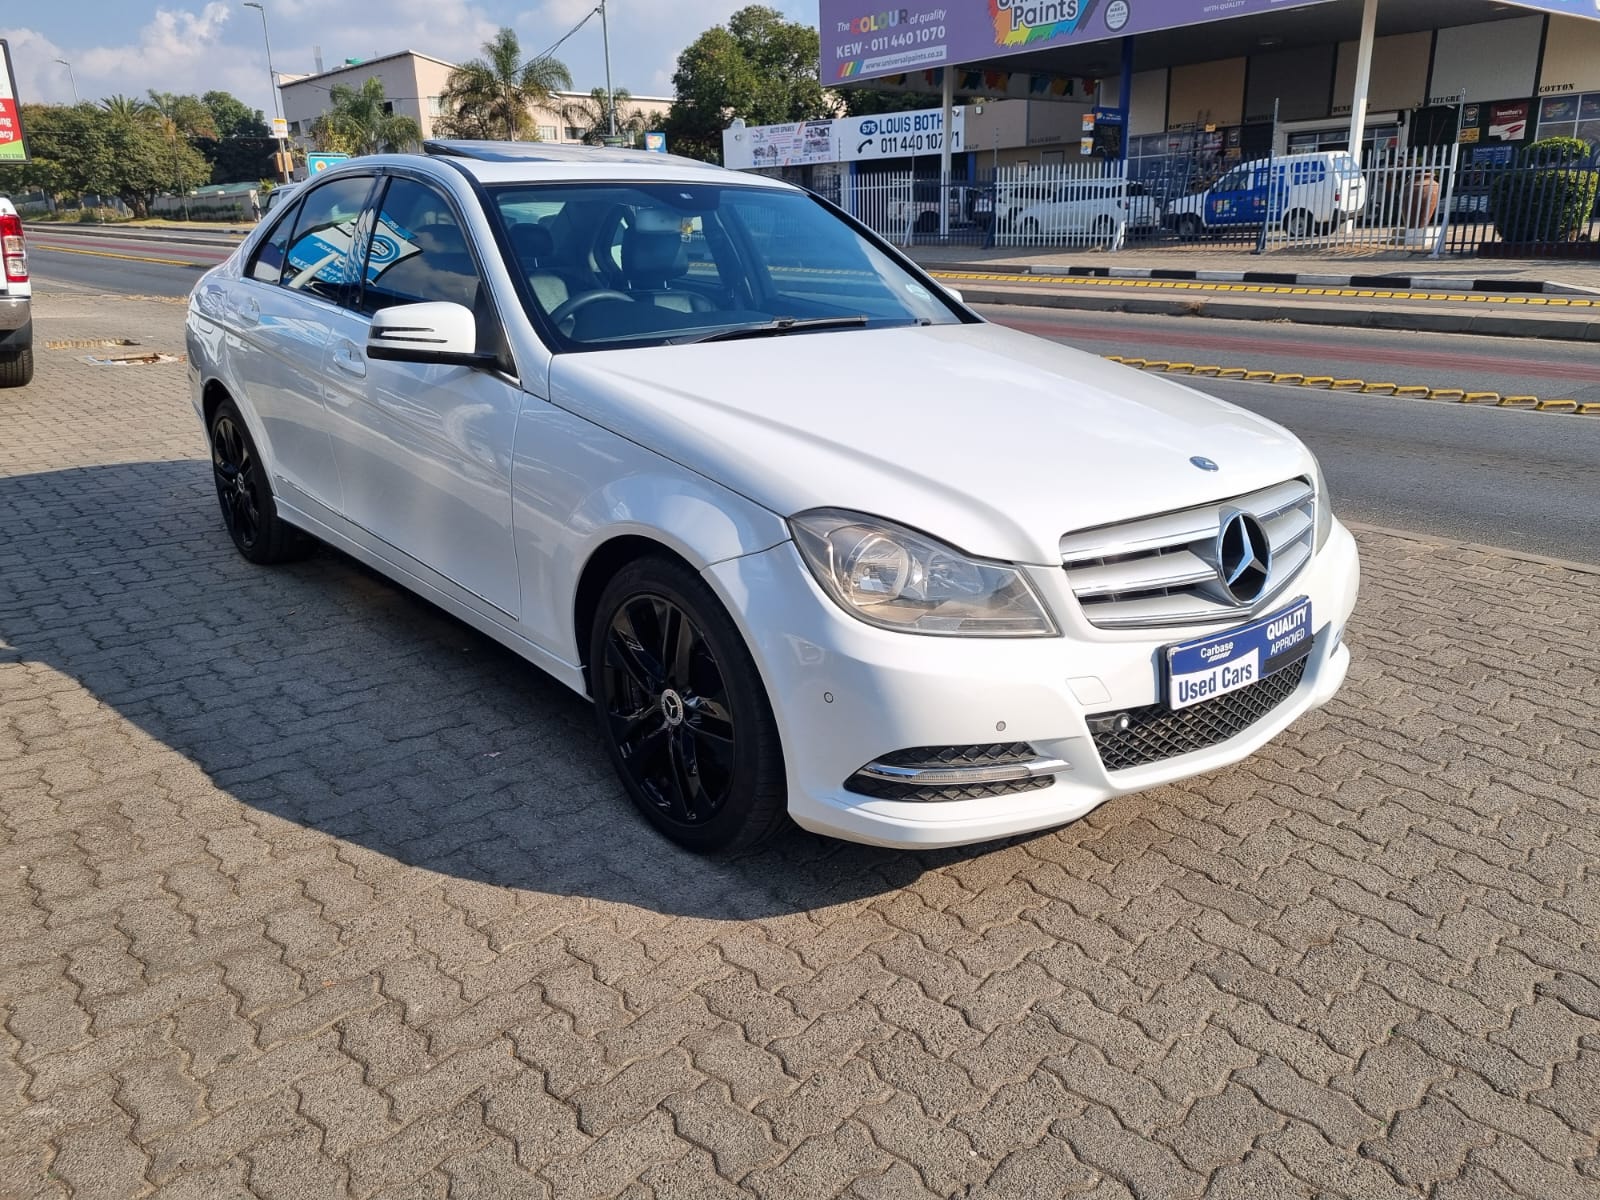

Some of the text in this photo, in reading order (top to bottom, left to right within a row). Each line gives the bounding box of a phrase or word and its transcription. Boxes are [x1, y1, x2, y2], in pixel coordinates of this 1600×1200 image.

[1013, 0, 1077, 27] Paints
[1203, 1, 1245, 12] WITH QUALITY
[837, 8, 947, 35] The COLOUR of quality
[836, 42, 862, 59] KEW
[871, 37, 888, 51] 011
[891, 32, 914, 47] 440
[916, 26, 945, 43] 1070
[1539, 82, 1575, 93] COTTON
[862, 113, 944, 134] 575 LOUIS BOTH
[881, 137, 897, 153] 011
[901, 134, 923, 151] 440
[1266, 606, 1308, 640] QUALITY
[1200, 641, 1234, 658] Carbase
[1270, 627, 1305, 655] APPROVED
[1179, 663, 1252, 703] Used Cars
